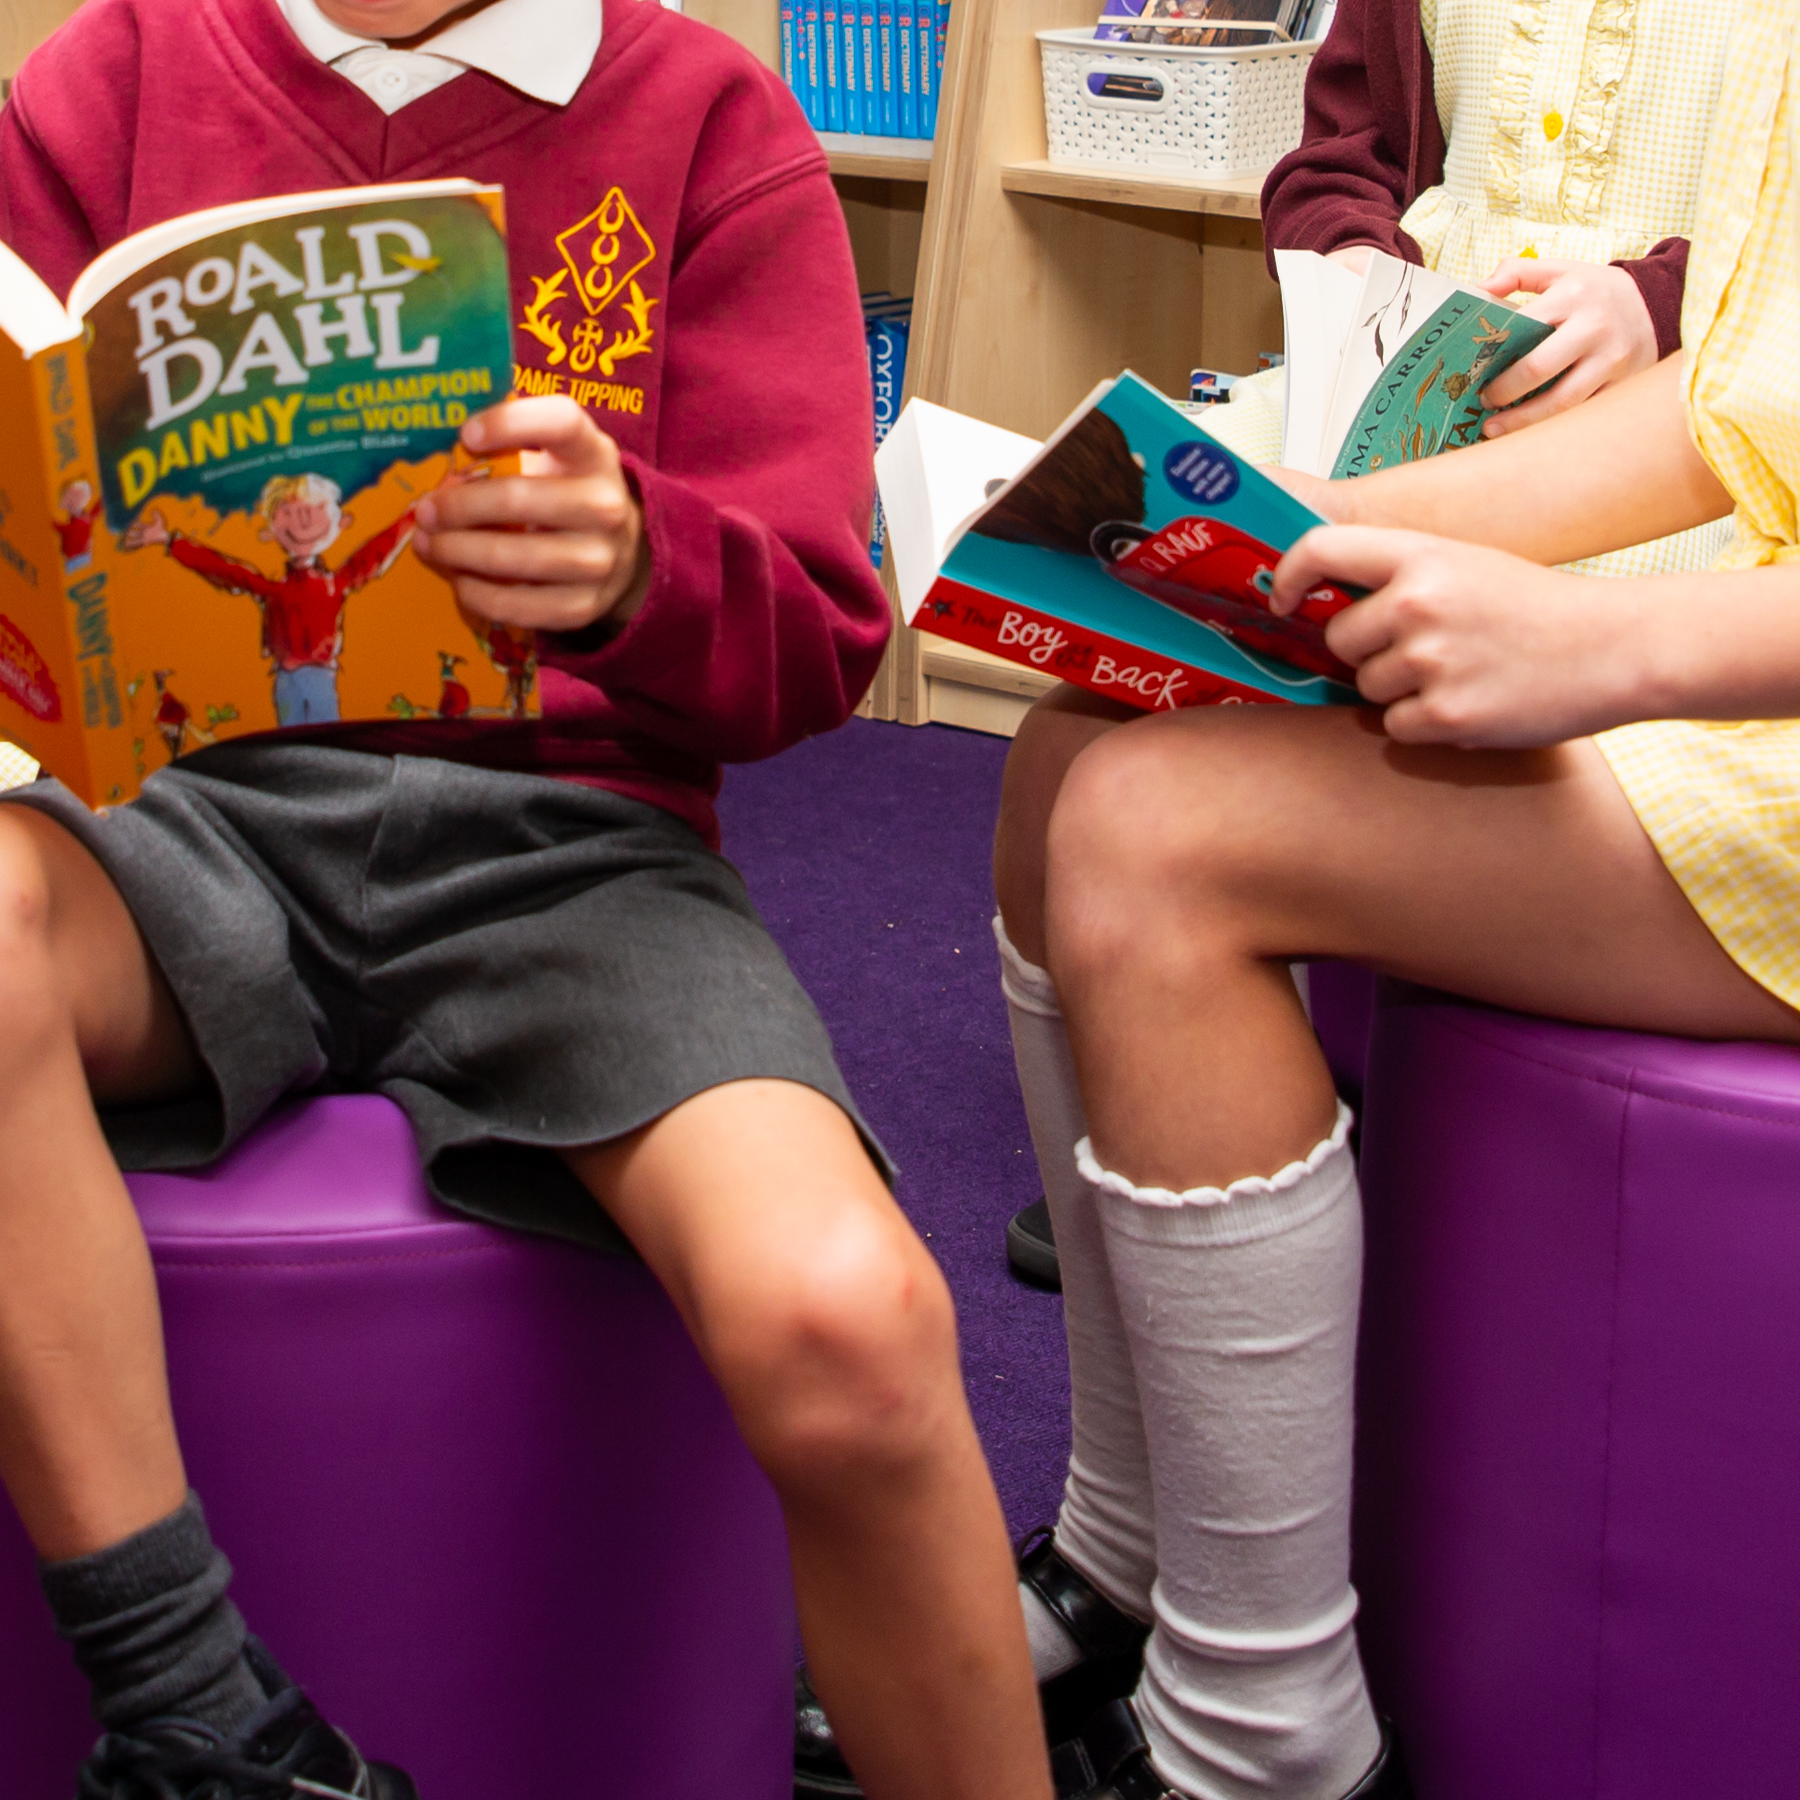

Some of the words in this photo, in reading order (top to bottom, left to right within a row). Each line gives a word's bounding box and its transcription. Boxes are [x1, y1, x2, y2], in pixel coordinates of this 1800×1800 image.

[127, 218, 434, 361] ROALD
[138, 290, 441, 433] DAHL
[568, 377, 645, 415] TIPPING
[874, 333, 894, 448] OXFOR
[1374, 301, 1472, 417] CARROLL
[116, 390, 303, 510] DANNY
[307, 393, 335, 412] THE
[336, 367, 491, 411] CHAMPION
[308, 420, 329, 437] OF
[332, 414, 361, 432] THE
[361, 401, 468, 433] WORLD
[360, 432, 411, 451] Blake
[1151, 520, 1215, 567] RAÚF
